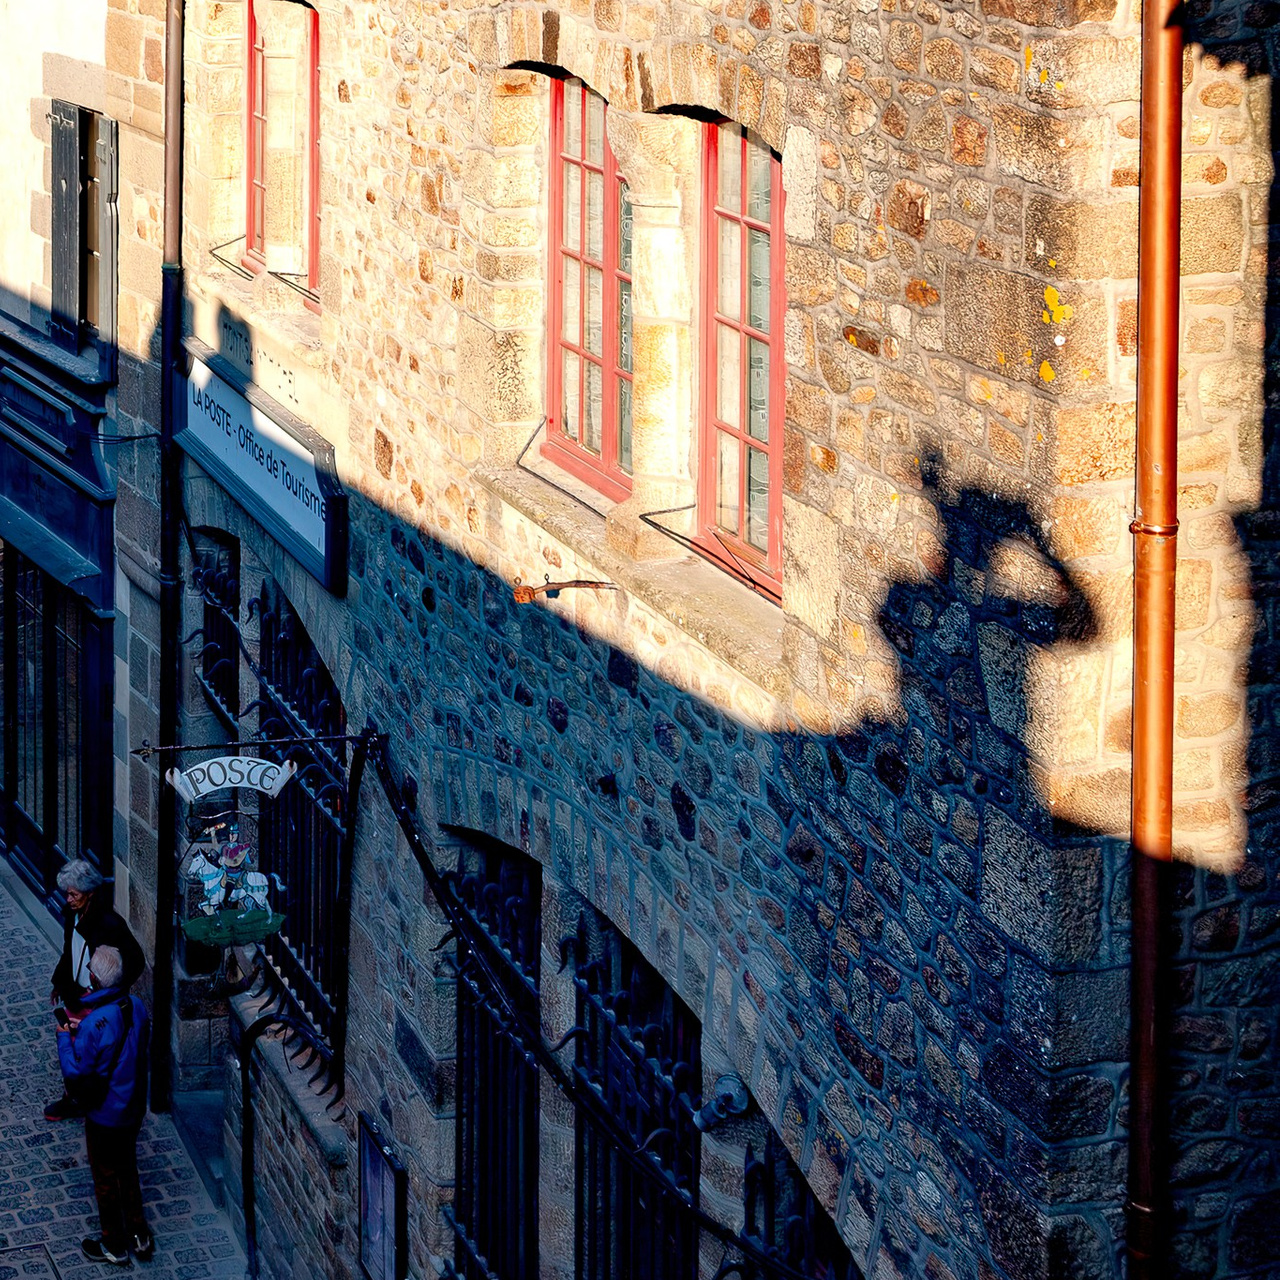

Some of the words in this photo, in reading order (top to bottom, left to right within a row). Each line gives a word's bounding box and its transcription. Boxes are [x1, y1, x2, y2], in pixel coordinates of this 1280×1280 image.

[193, 384, 203, 412] LA
[204, 395, 231, 437] POSTE
[238, 424, 265, 466] Office
[267, 450, 279, 479] de
[280, 460, 326, 522] Tourisme
[184, 758, 281, 797] POSTE
